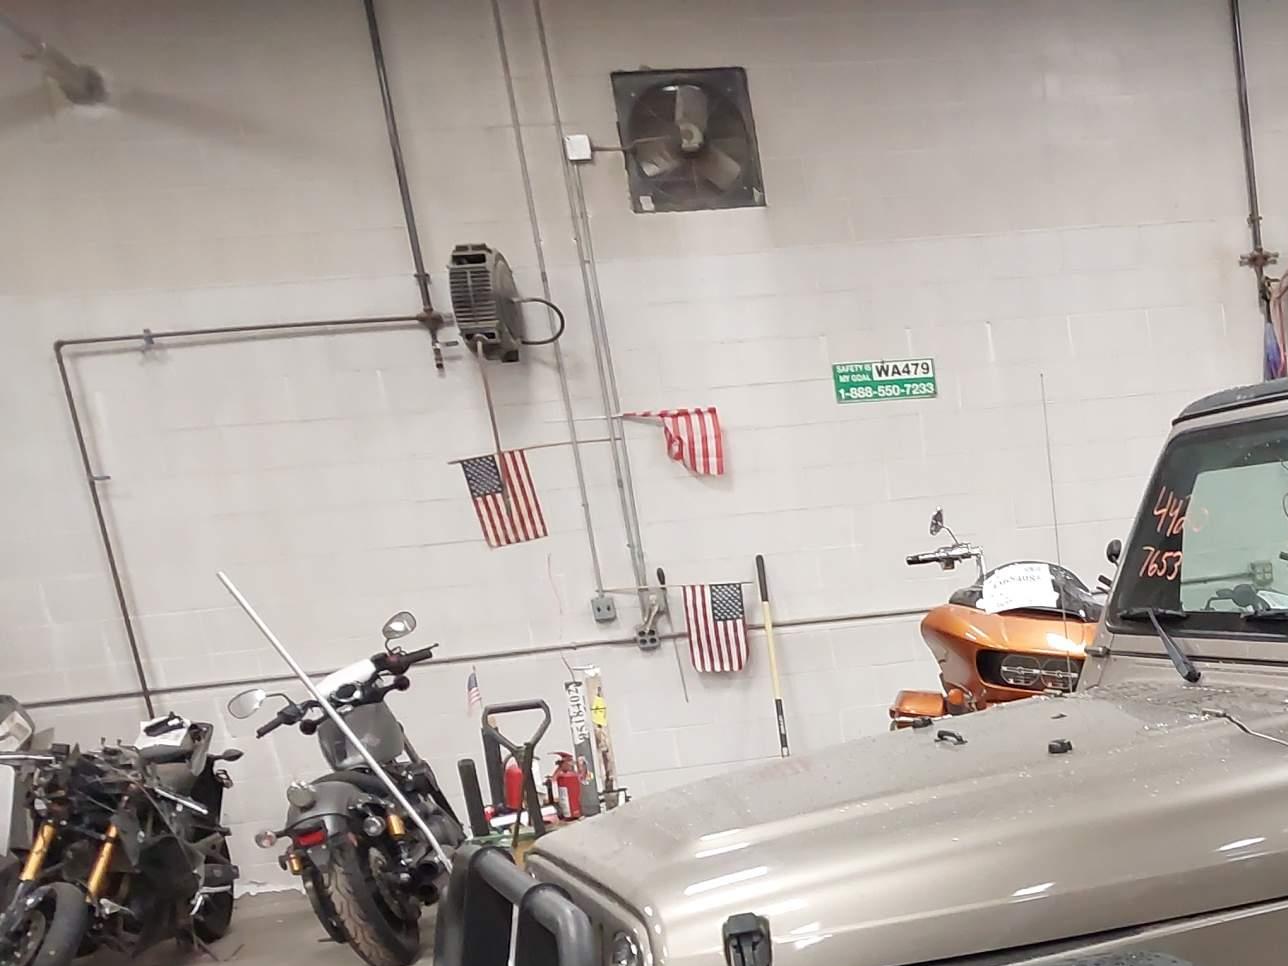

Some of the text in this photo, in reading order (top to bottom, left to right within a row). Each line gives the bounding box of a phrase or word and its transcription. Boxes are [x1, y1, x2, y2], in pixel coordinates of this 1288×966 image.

[836, 364, 864, 374] SAFETY
[875, 362, 930, 378] WA479
[839, 374, 850, 383] MY
[839, 382, 934, 400] 1-888-550-7233
[1140, 545, 1183, 580] 7653
